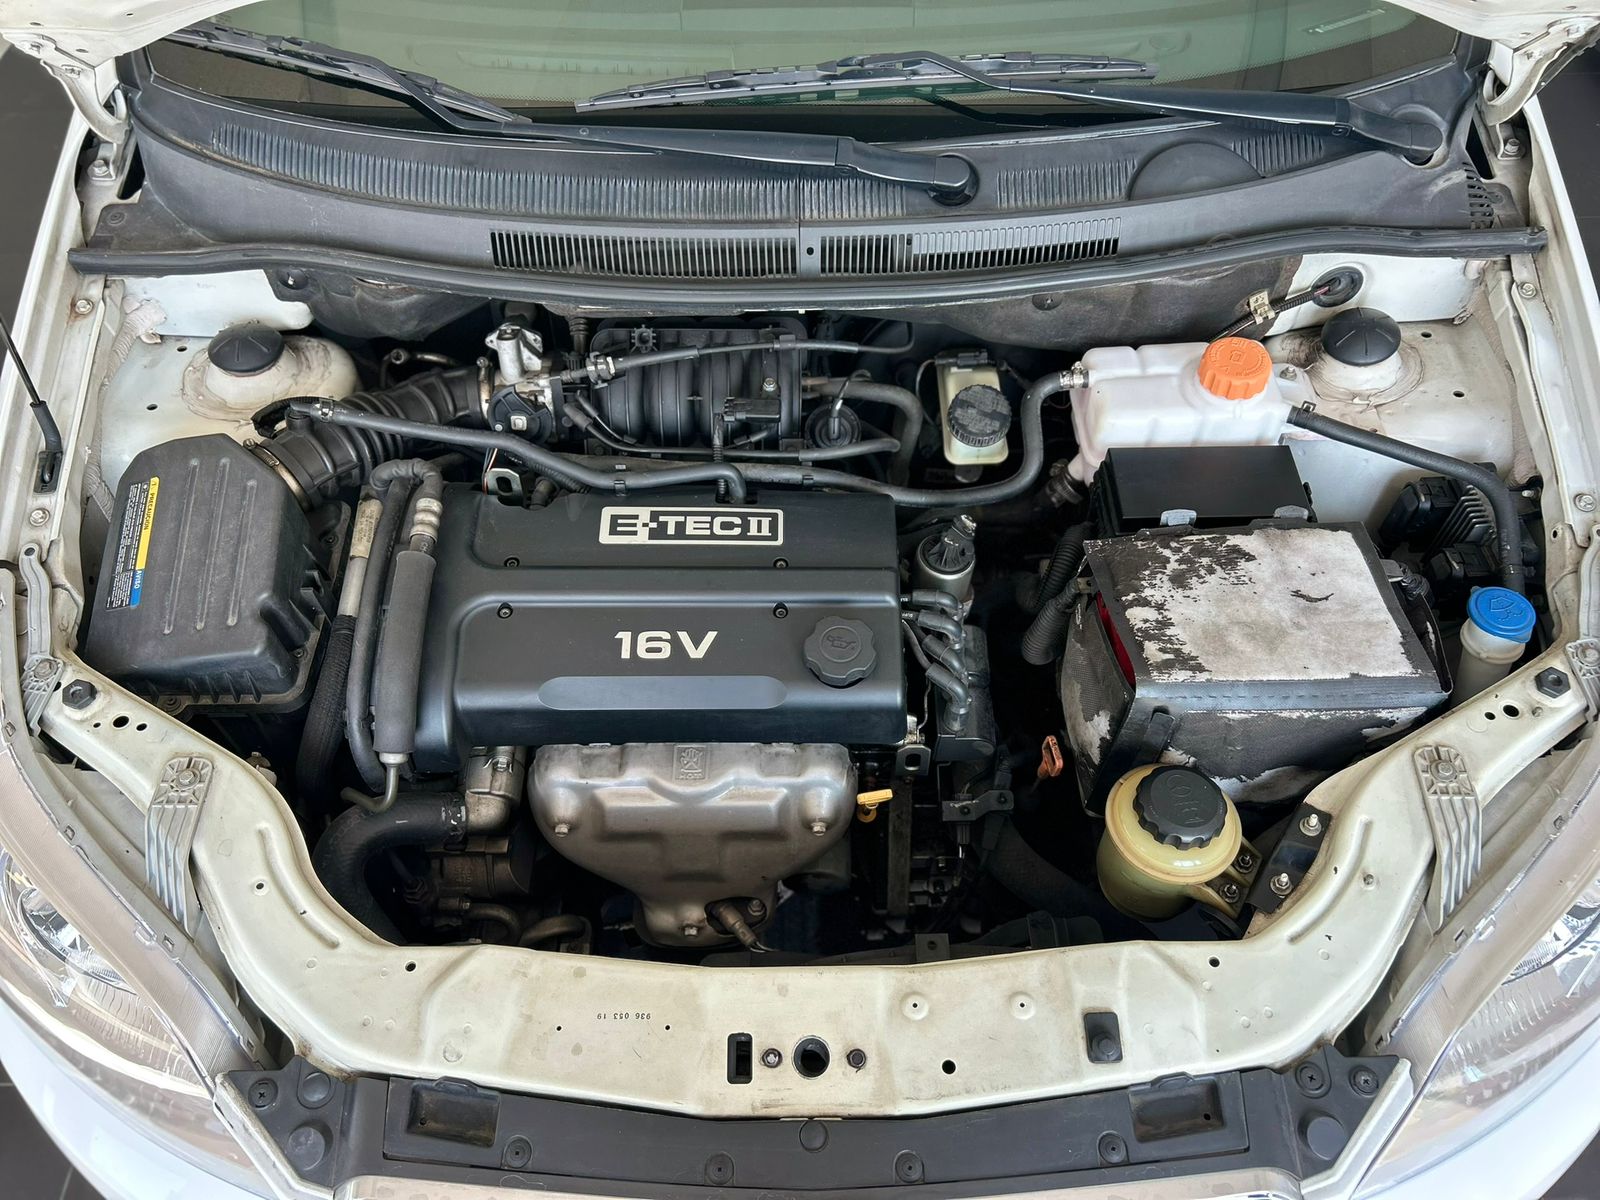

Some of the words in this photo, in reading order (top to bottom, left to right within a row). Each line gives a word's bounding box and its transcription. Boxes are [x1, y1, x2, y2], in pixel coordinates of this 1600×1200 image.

[608, 514, 742, 537] E-TEC
[134, 570, 142, 589] AVISO
[614, 630, 719, 659] 16V
[613, 1012, 630, 1020] 053
[635, 1012, 651, 1020] 936
